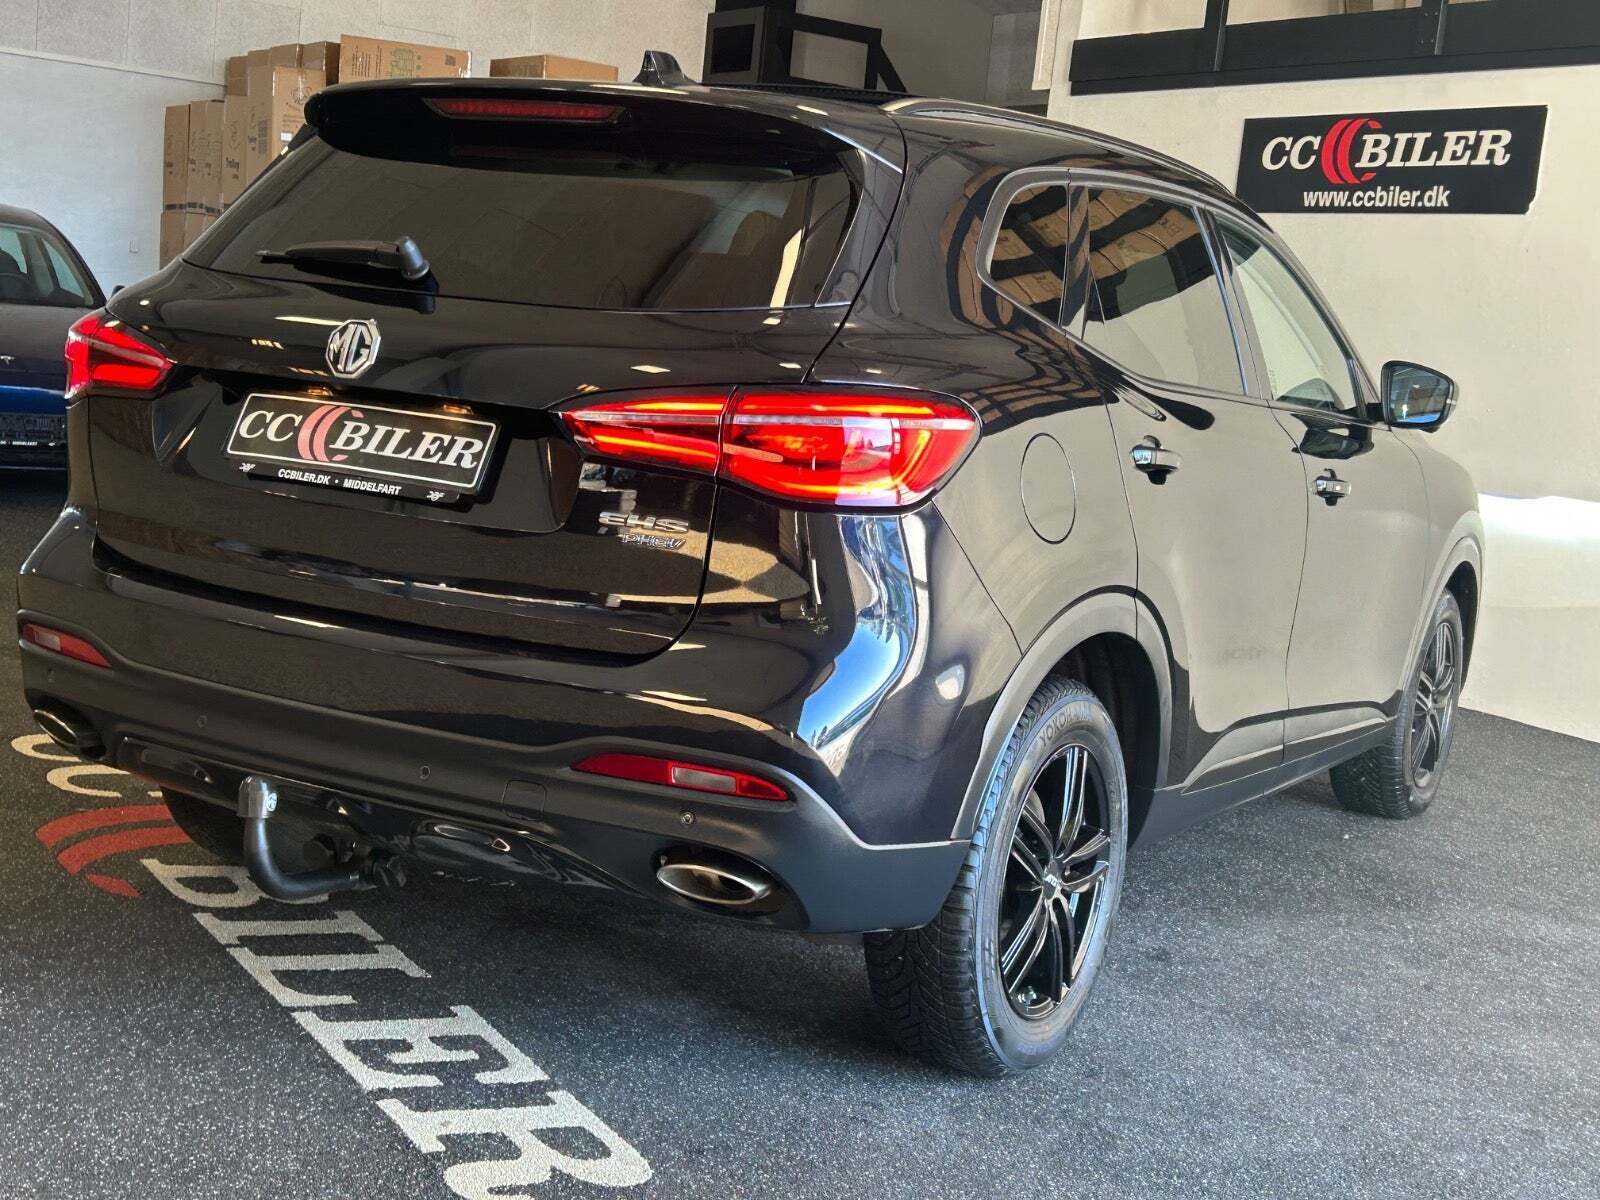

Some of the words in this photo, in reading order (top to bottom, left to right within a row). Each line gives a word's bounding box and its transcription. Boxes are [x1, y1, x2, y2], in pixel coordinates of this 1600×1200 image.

[1355, 128, 1513, 169] BILER
[1302, 185, 1452, 208] www.ccbiler.dk
[328, 322, 372, 373] MG
[328, 420, 485, 469] BILER
[277, 467, 332, 486] CCBILER.DK
[342, 478, 402, 497] MIDDELFART
